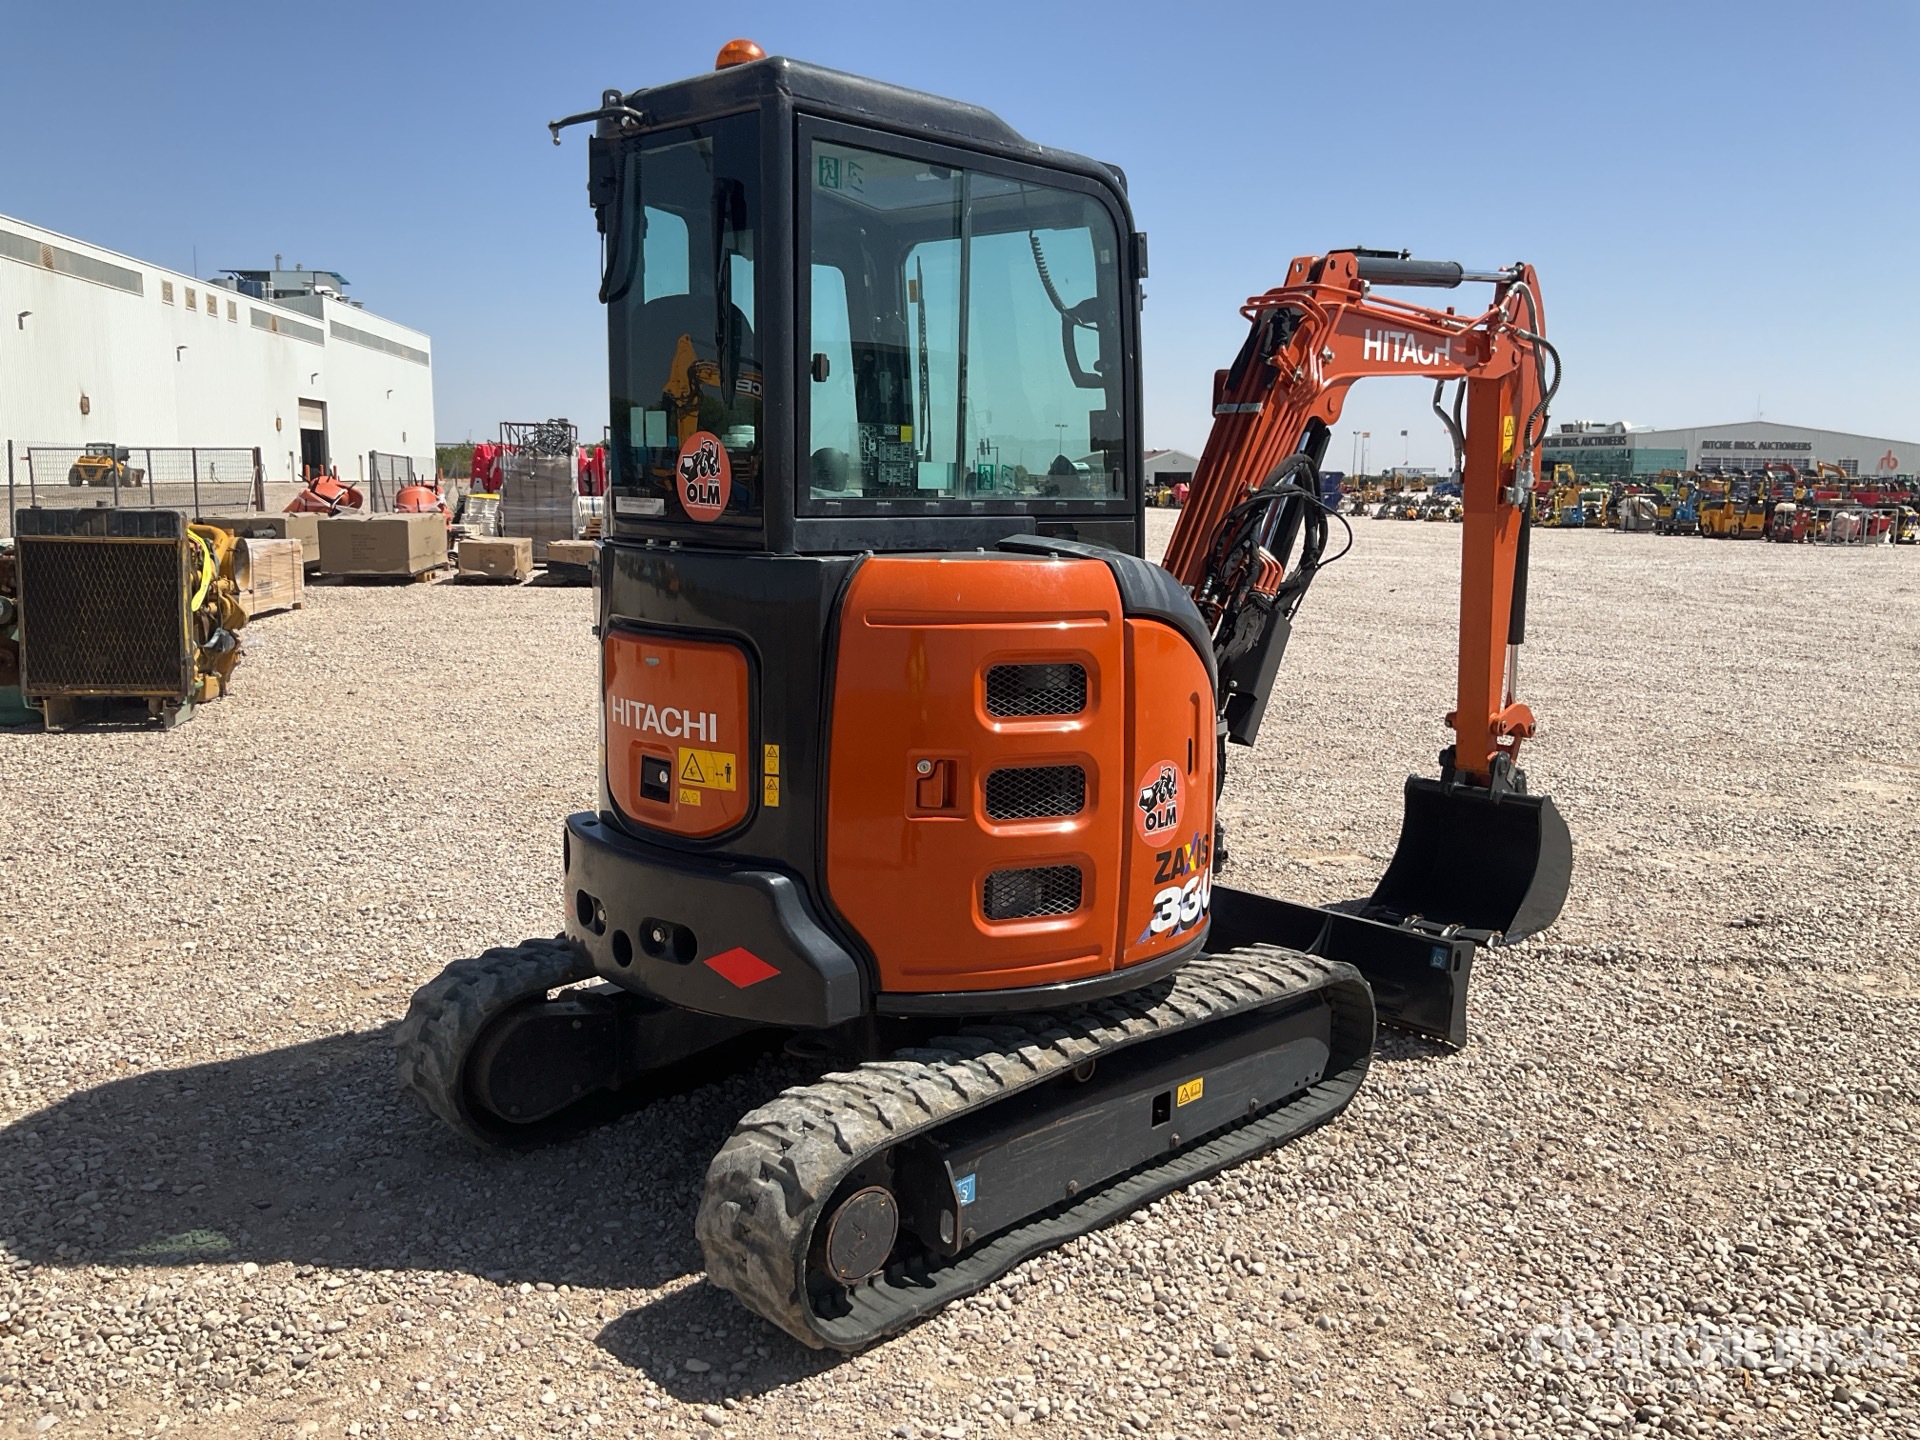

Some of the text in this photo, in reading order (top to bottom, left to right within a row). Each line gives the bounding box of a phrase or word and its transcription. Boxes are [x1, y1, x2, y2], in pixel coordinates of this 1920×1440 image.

[1580, 435, 1627, 447] AUCTIONEERS
[1702, 440, 1733, 450] RITCHIE
[1758, 441, 1812, 450] AUCTIONEERS
[686, 483, 721, 506] OLM
[612, 695, 717, 743] HITACHI
[1145, 806, 1177, 831] OLM
[1153, 831, 1209, 886] ZAXIS
